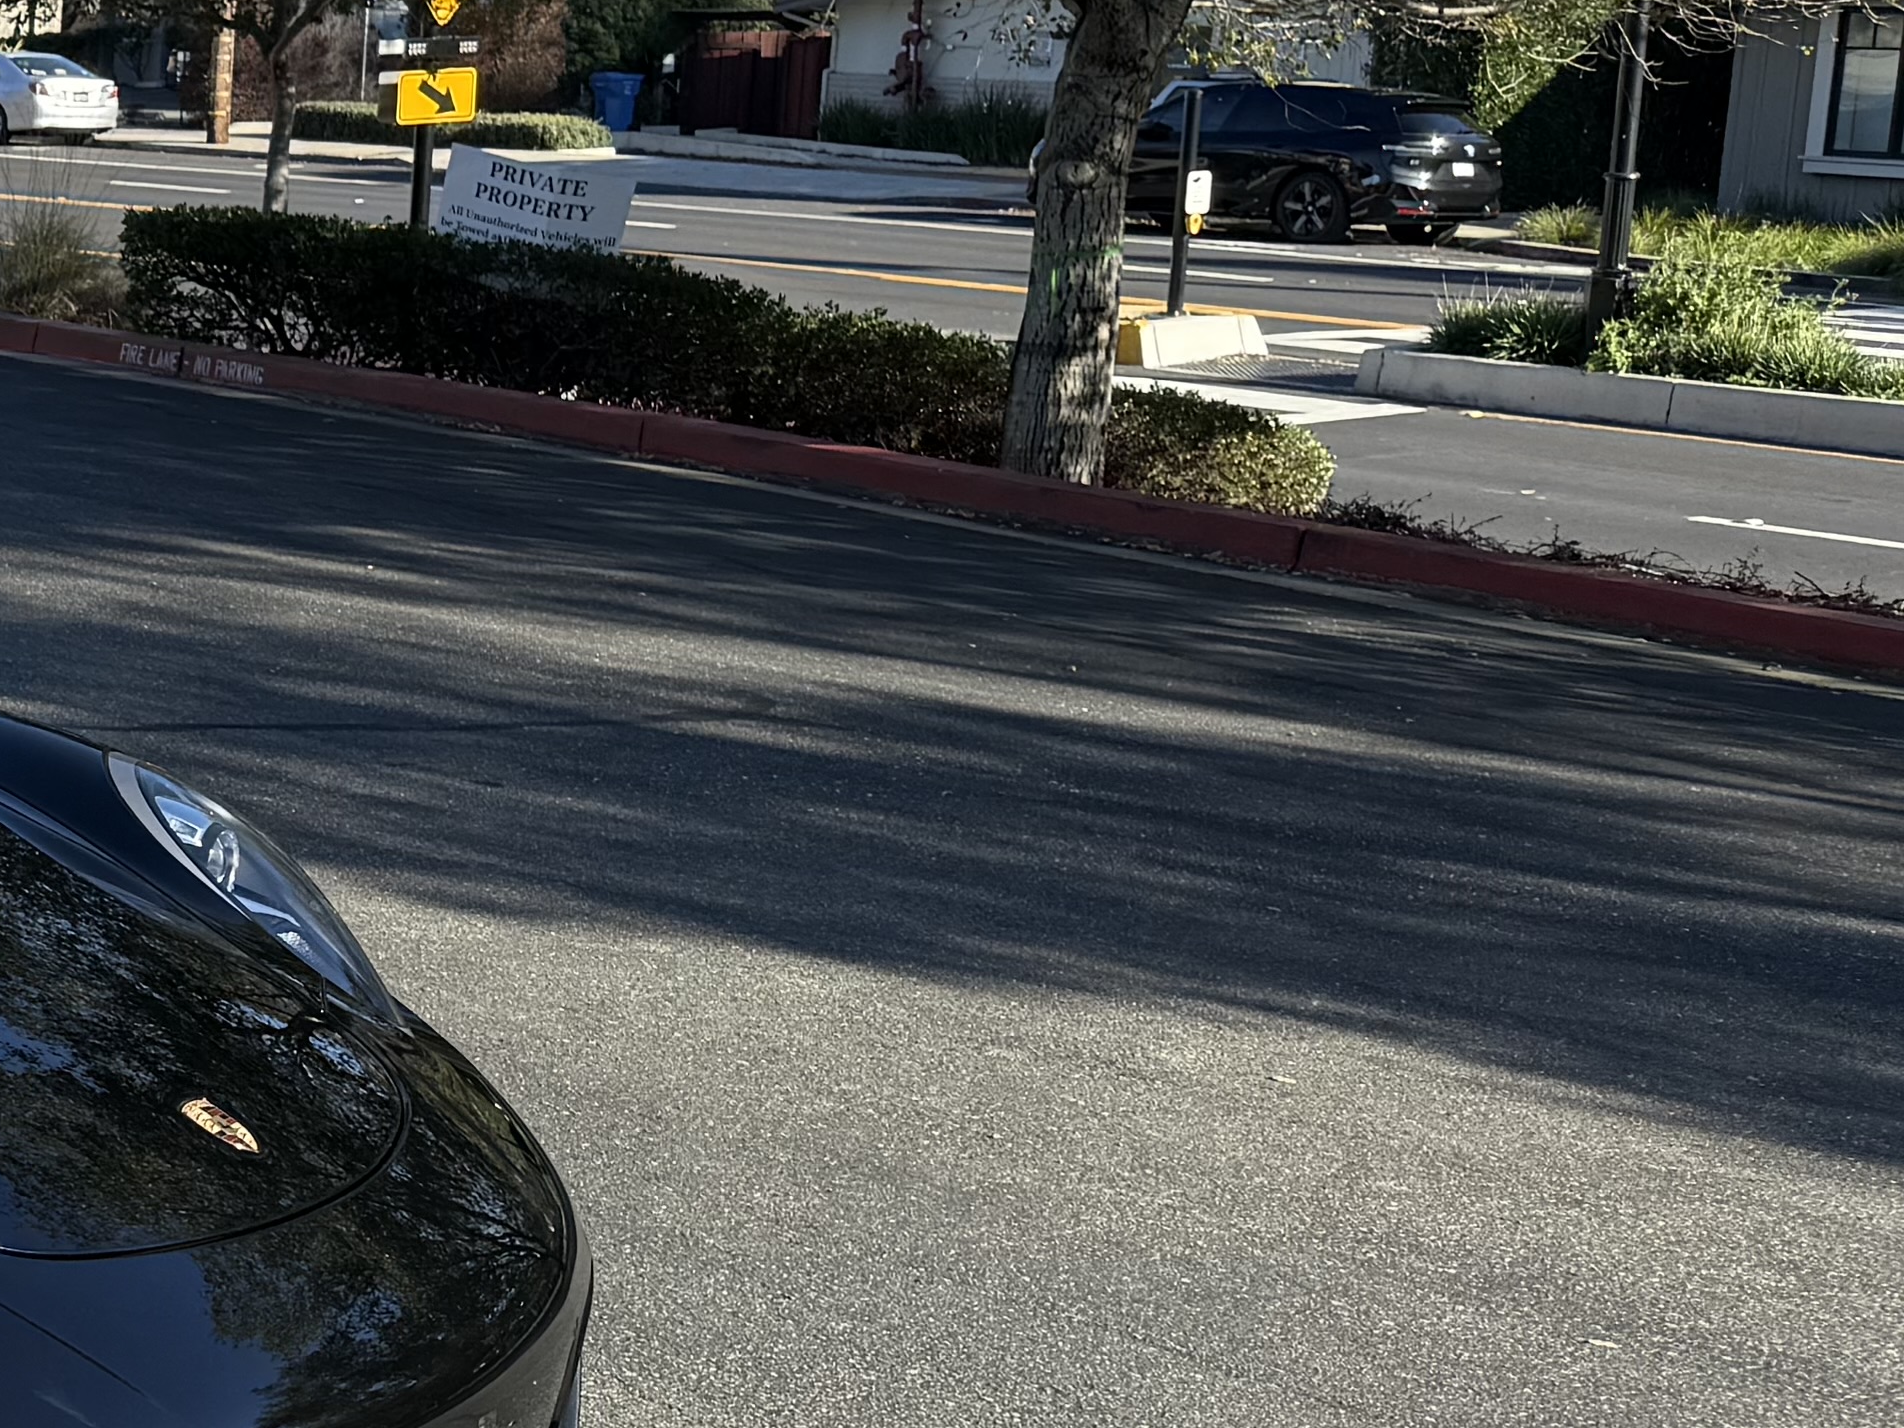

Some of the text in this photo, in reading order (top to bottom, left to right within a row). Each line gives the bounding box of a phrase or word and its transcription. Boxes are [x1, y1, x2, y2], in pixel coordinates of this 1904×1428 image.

[490, 161, 589, 198] PRIVATE
[474, 181, 597, 222] PROPERTY
[448, 204, 464, 217] All
[465, 208, 539, 237] Unauthorized
[540, 229, 591, 246] Vehicles
[593, 235, 616, 247] will
[119, 342, 146, 365] FIRE
[148, 348, 182, 371] LANE
[193, 355, 211, 377] NO
[214, 359, 265, 385] PARKING
